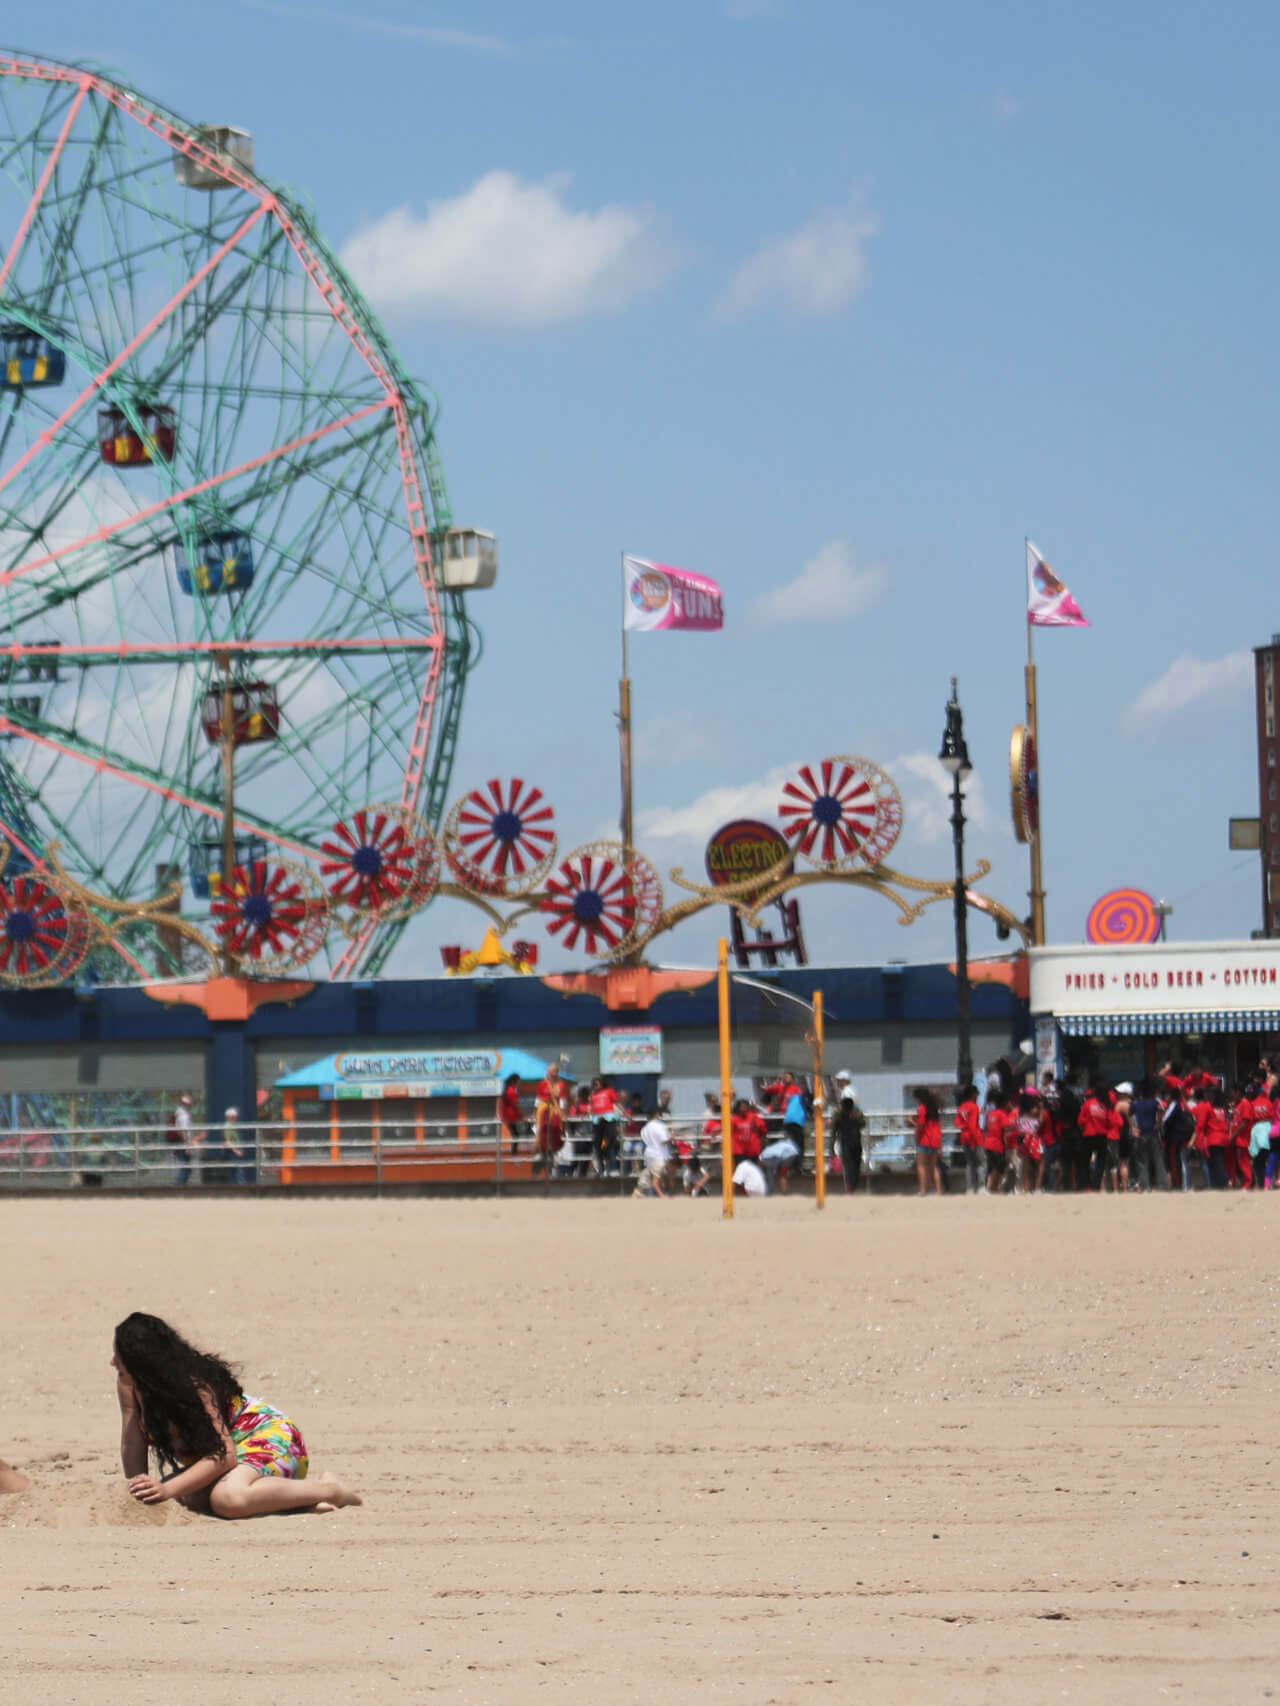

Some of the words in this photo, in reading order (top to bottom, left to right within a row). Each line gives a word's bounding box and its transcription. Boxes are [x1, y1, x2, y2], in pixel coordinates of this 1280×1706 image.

[709, 840, 789, 869] ELECTRO
[1066, 973, 1105, 991] FRIES
[1124, 971, 1159, 989] COLD
[1167, 970, 1203, 987] BEER
[1224, 968, 1277, 986] COTTON
[389, 1057, 428, 1073] PARK
[432, 1055, 491, 1072] TICKETS
